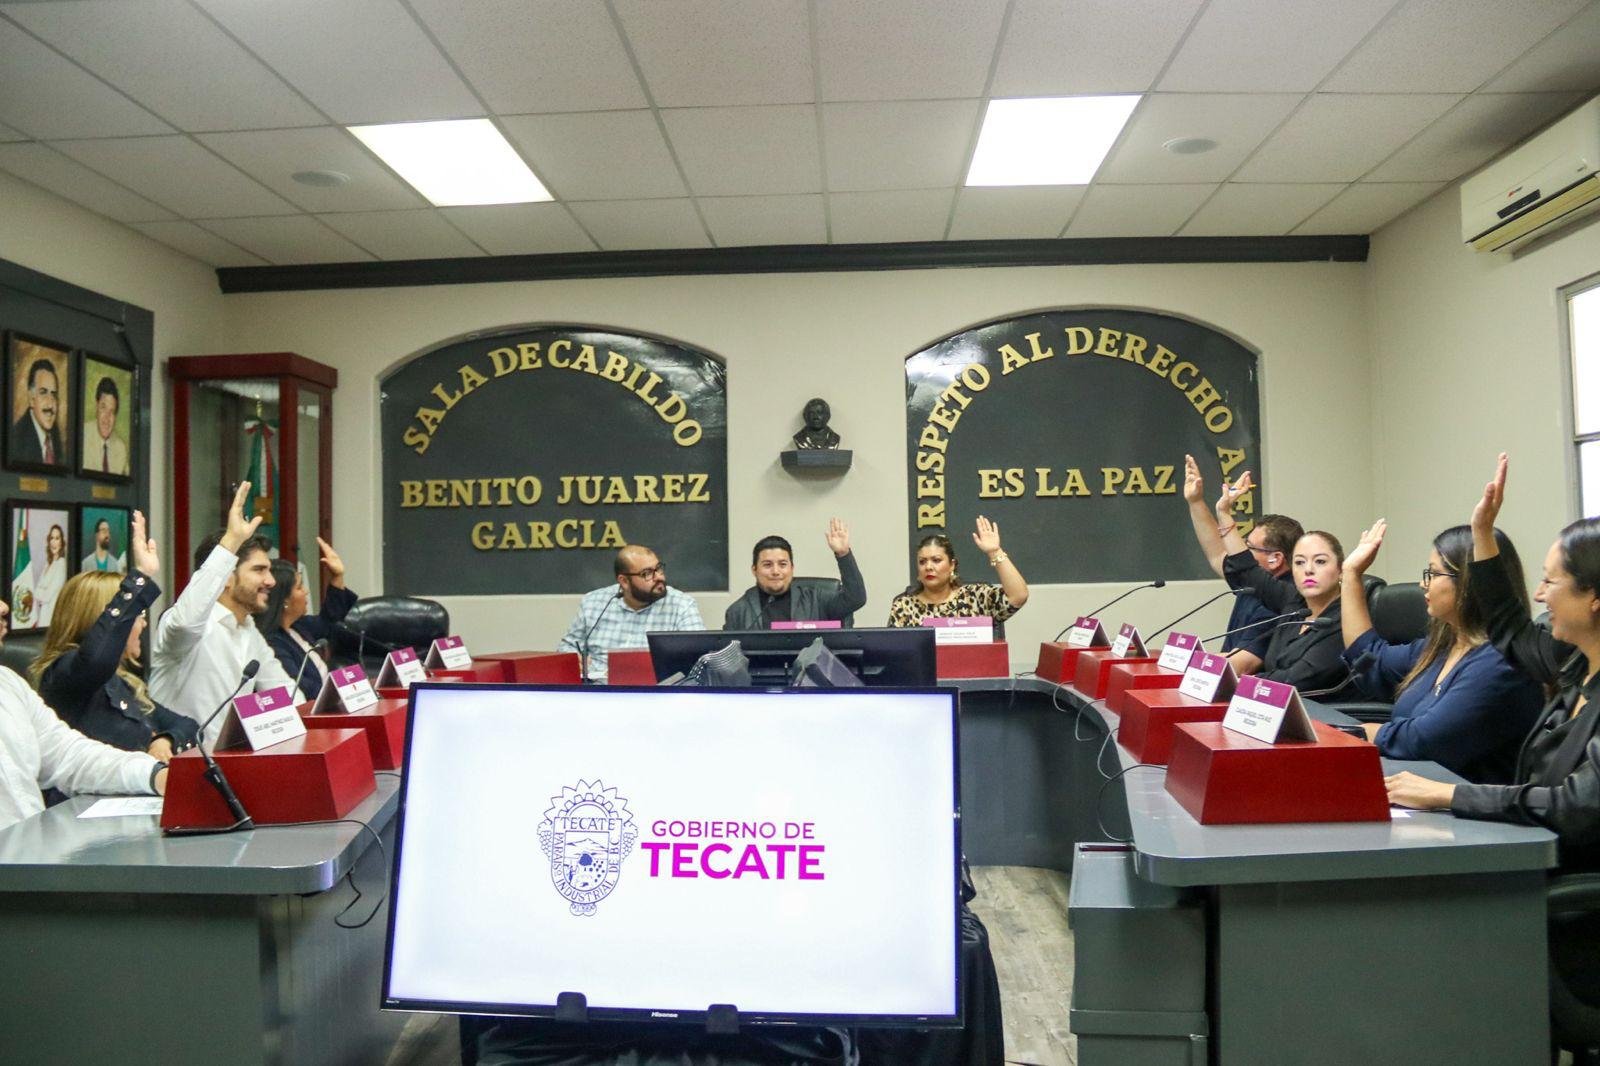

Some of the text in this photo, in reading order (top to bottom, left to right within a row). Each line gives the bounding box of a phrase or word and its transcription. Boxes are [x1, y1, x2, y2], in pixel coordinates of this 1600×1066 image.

[403, 340, 703, 454] SALA DE CABILDO
[917, 362, 991, 528] RESPETO
[997, 332, 1054, 375] AL
[1065, 326, 1234, 434] DERECHO
[400, 474, 710, 508] BENITO JUAREZ
[978, 465, 1177, 498] ES LA PAZ
[472, 519, 627, 551] GARCIA
[560, 816, 616, 831] TECATE
[652, 820, 815, 840] GOBIERNO DE
[641, 842, 825, 880] TECATE
[556, 878, 616, 901] INDUSTRIAL
